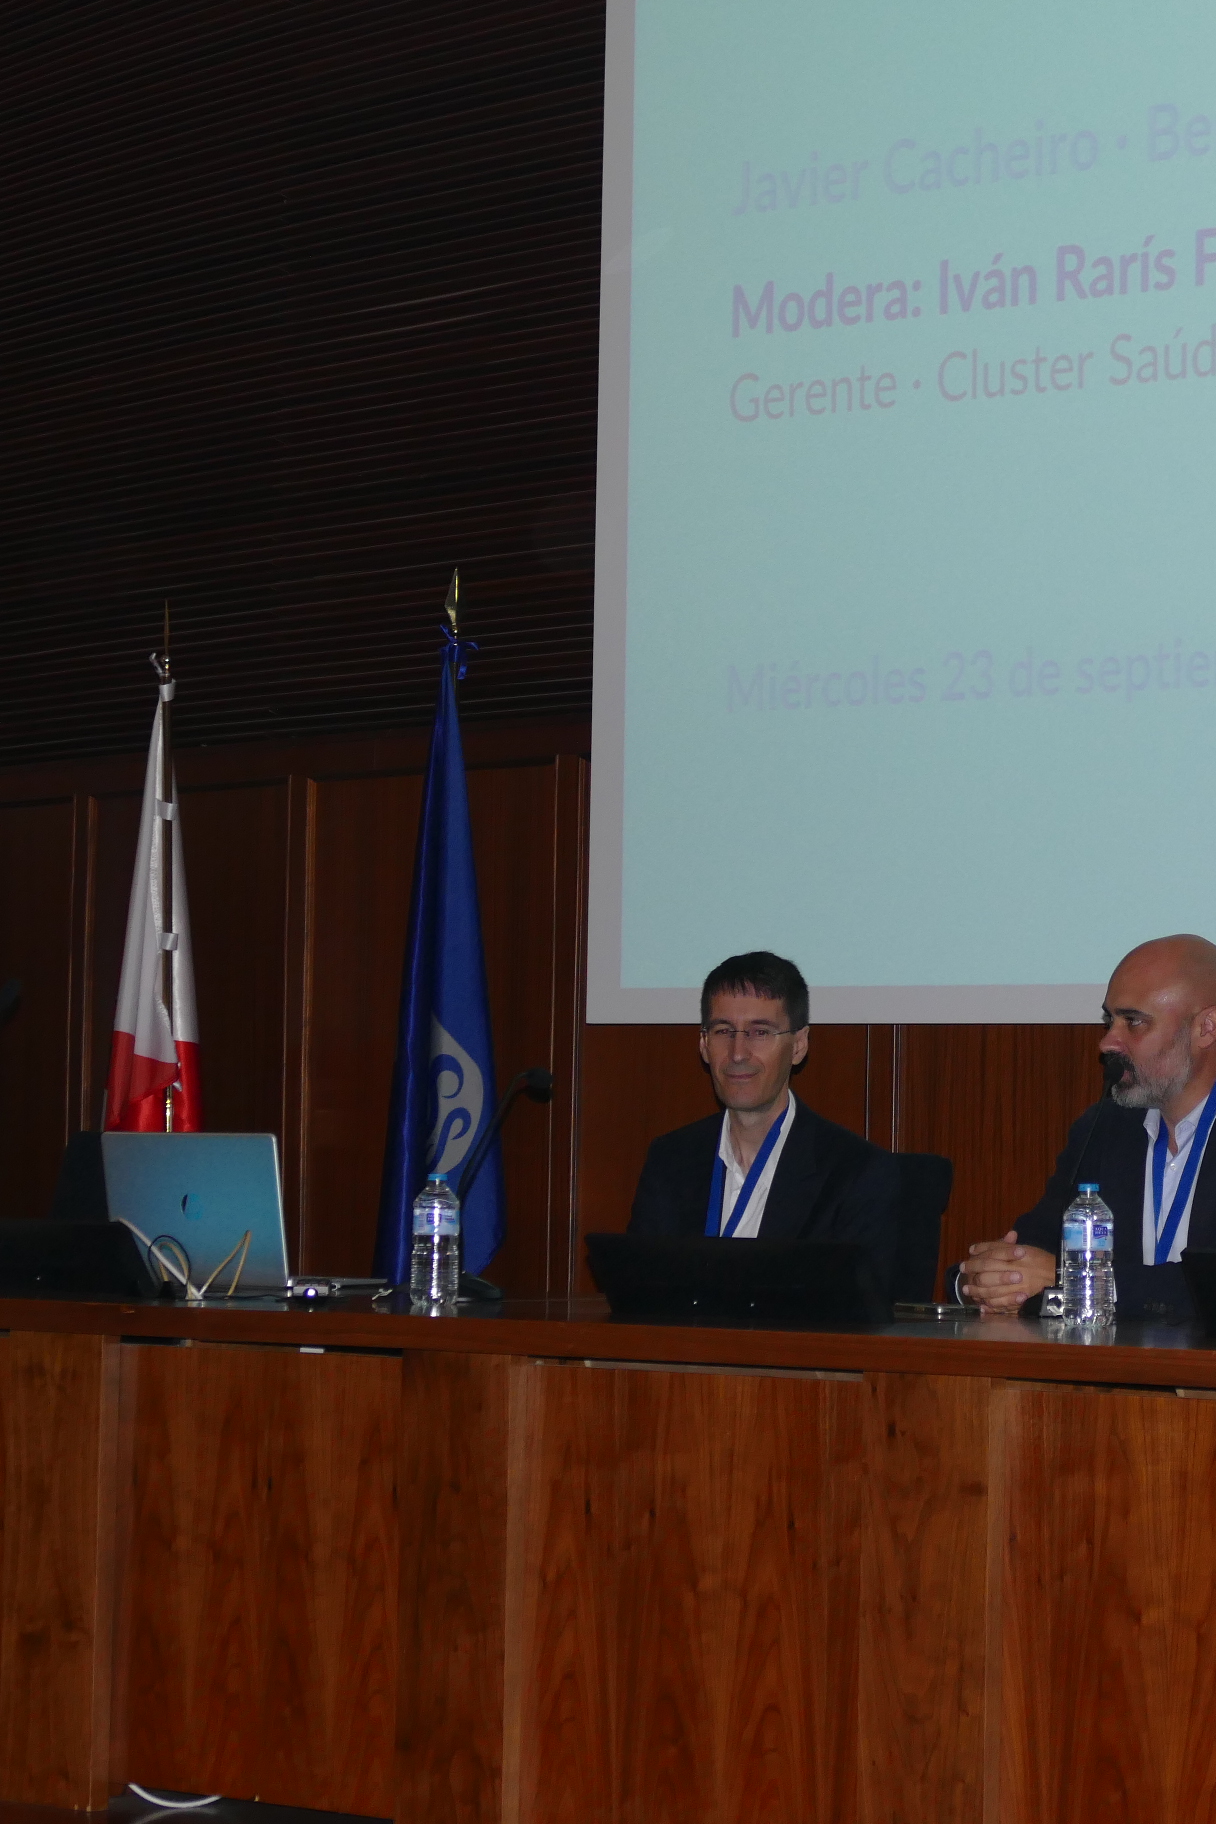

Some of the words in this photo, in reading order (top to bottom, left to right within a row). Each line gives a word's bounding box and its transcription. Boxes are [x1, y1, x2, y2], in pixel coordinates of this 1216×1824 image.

[730, 152, 871, 217] Javier
[884, 119, 1099, 198] Cacheiro
[731, 273, 922, 338] Modera:
[938, 252, 1038, 315] Iván
[1055, 235, 1177, 302] Rarís
[728, 363, 898, 423] Gerente
[937, 349, 1094, 403] Cluster
[726, 655, 927, 713] Miércoles
[941, 649, 994, 703] 23
[1009, 645, 1062, 698] de
